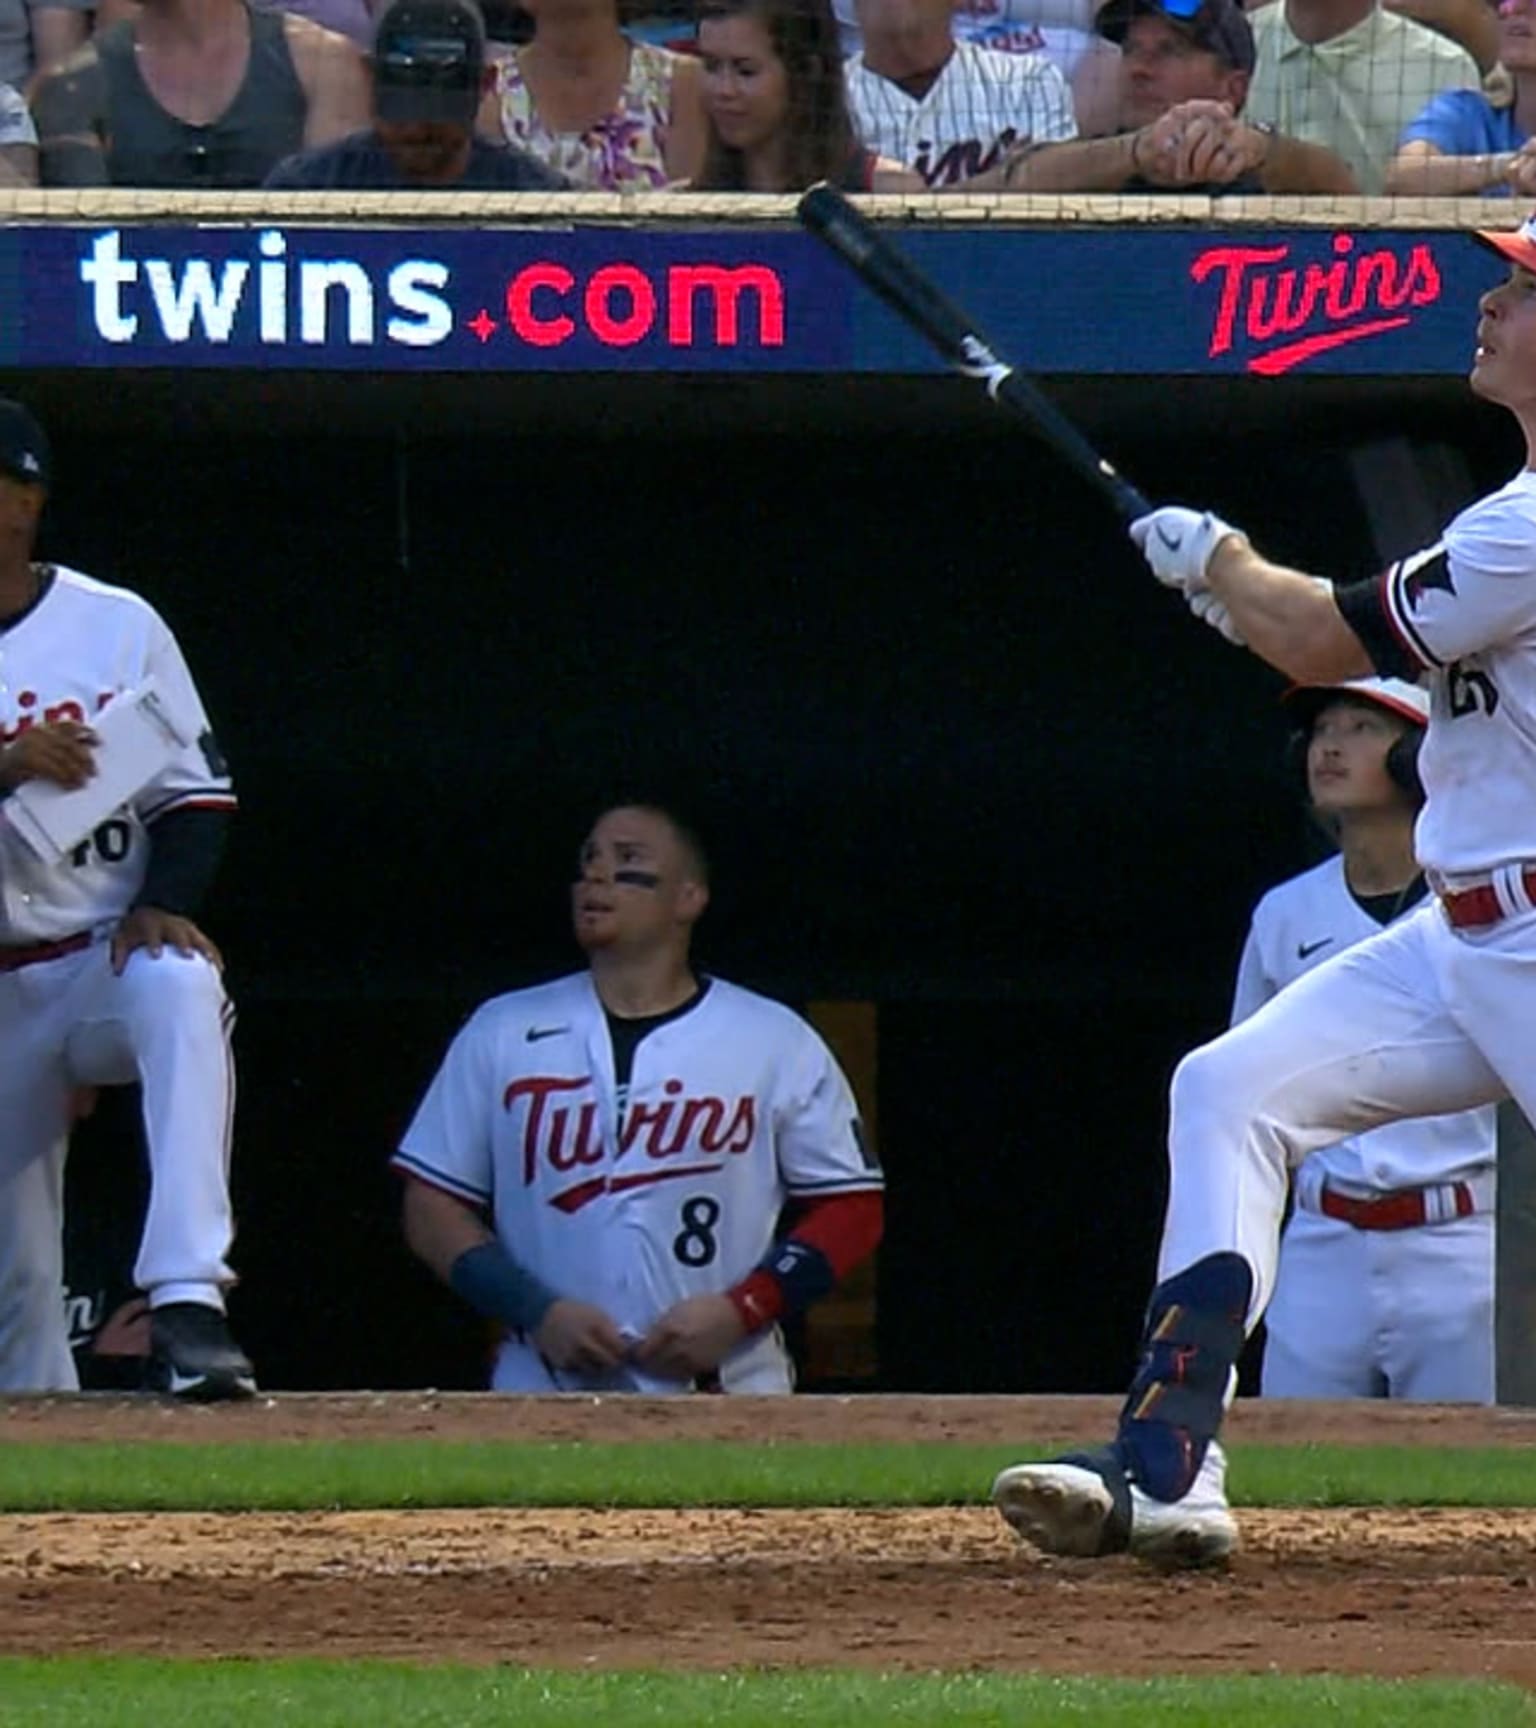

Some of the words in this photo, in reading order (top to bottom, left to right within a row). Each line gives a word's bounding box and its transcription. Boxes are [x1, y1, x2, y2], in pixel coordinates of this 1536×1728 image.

[80, 230, 785, 346] twins.com
[1190, 234, 1441, 359] Twins
[503, 1077, 756, 1188] Twins
[672, 1197, 720, 1267] 8
